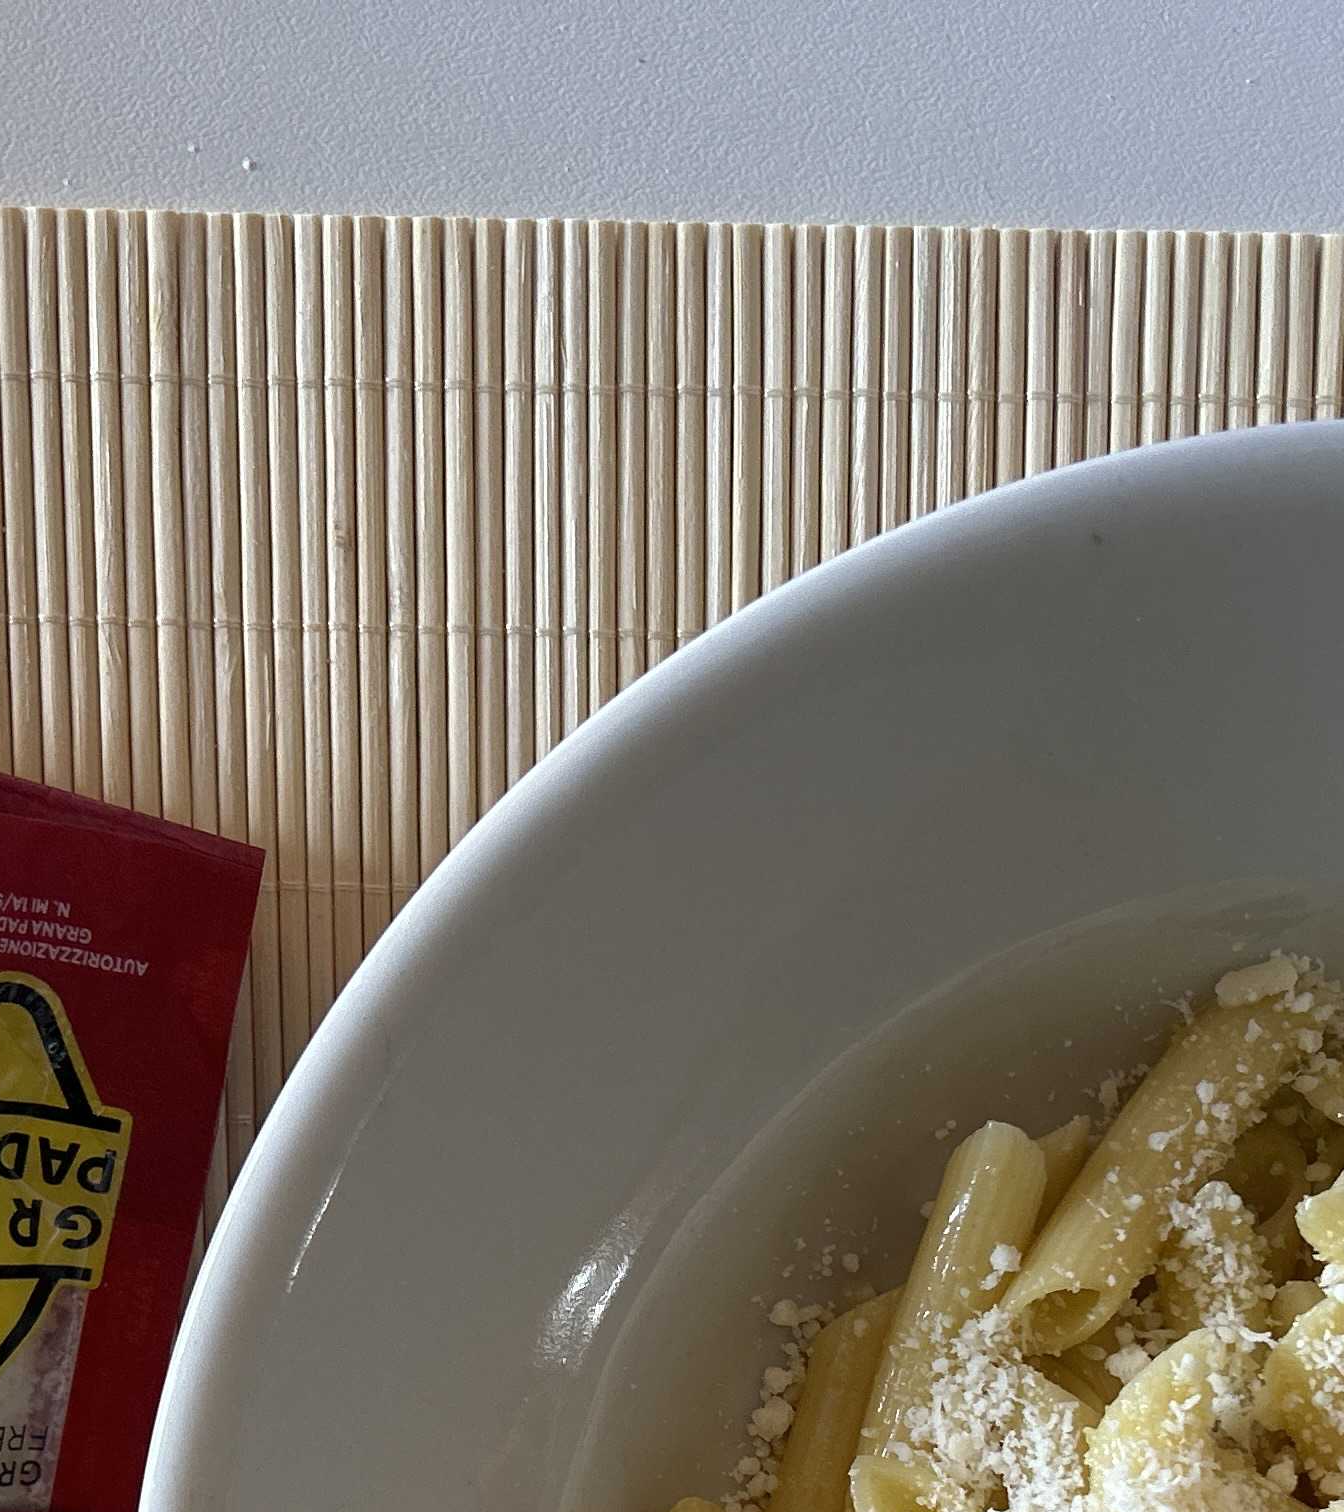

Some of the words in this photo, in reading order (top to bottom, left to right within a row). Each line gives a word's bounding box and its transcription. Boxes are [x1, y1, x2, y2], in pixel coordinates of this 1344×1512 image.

[32, 897, 49, 913] MI
[54, 901, 70, 917] N.
[32, 920, 92, 944] GRANA
[0, 938, 149, 976] AUTORIZZAZIONE
